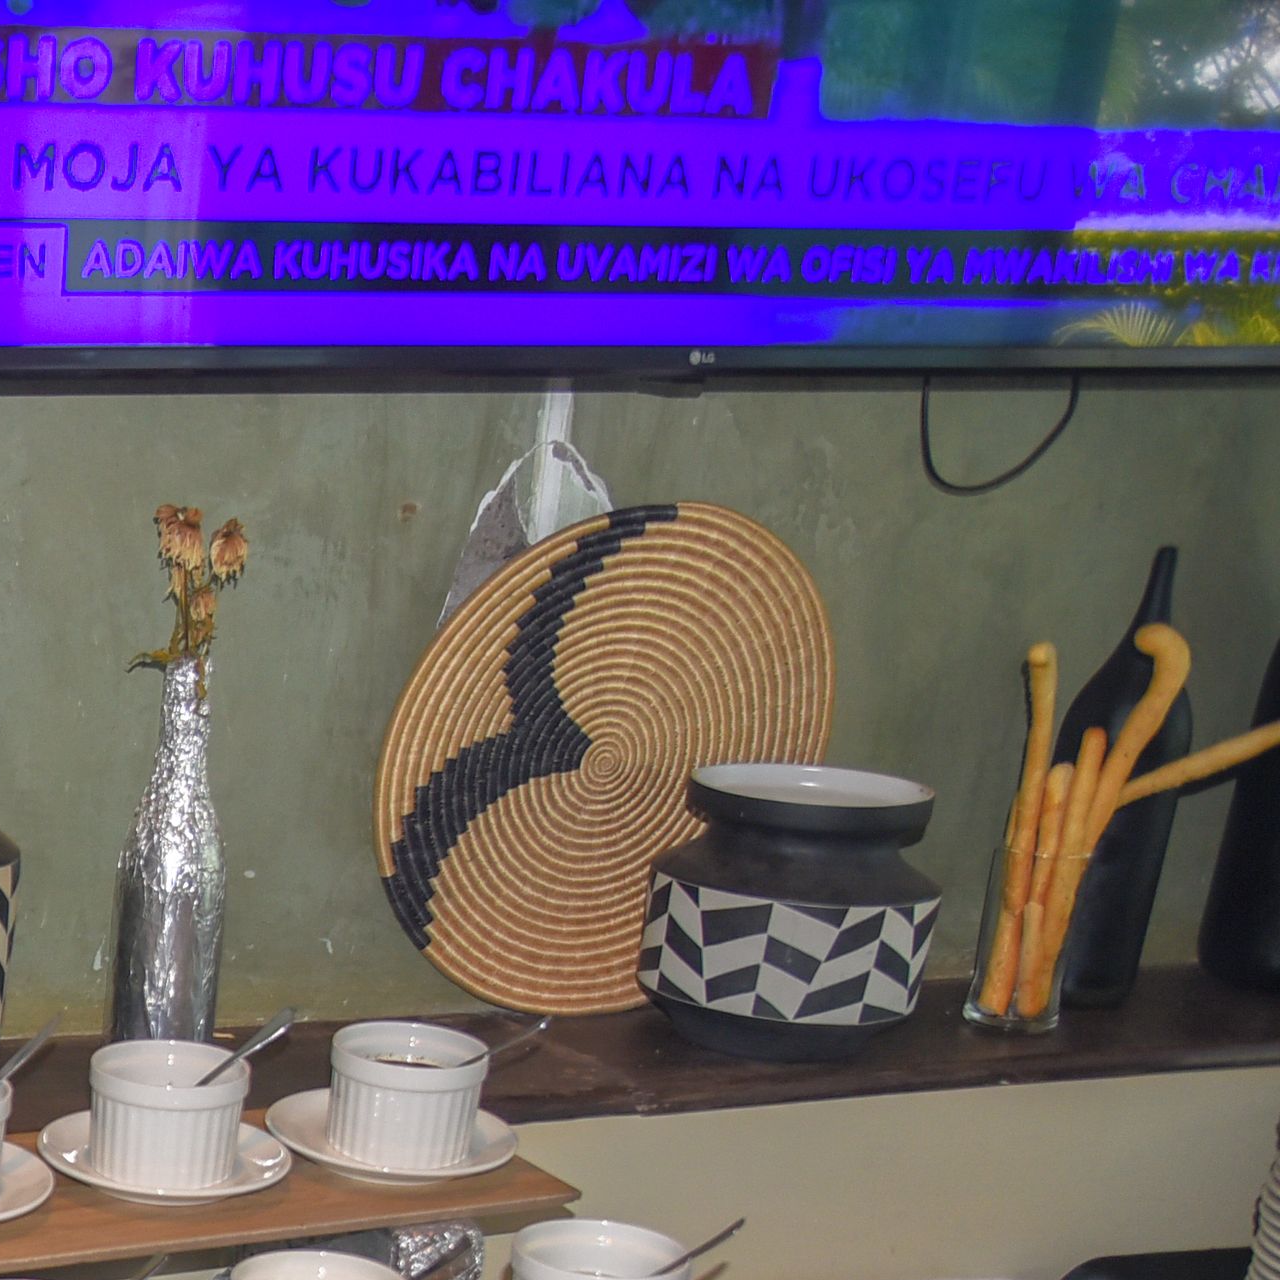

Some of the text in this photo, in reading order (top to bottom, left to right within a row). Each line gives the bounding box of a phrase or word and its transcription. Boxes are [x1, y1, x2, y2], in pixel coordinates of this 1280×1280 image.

[134, 36, 425, 106] KUHUSU
[440, 46, 753, 114] CHAKULA
[12, 142, 183, 192] MOJA
[208, 145, 284, 193] YA
[307, 146, 690, 198] KUKABILIANA
[712, 154, 784, 199] NA
[809, 155, 1048, 202] UKOSEFU
[1071, 161, 1148, 201] WA
[1170, 162, 1280, 204] CHA
[80, 238, 263, 281] ADAIWA
[272, 239, 479, 283] KUHUSIKA
[488, 240, 547, 283] NA
[555, 241, 719, 283] UVAMIZI
[726, 243, 792, 285] WA
[800, 245, 898, 286] OFISI
[906, 246, 955, 286] YA
[1183, 248, 1240, 285] WA
